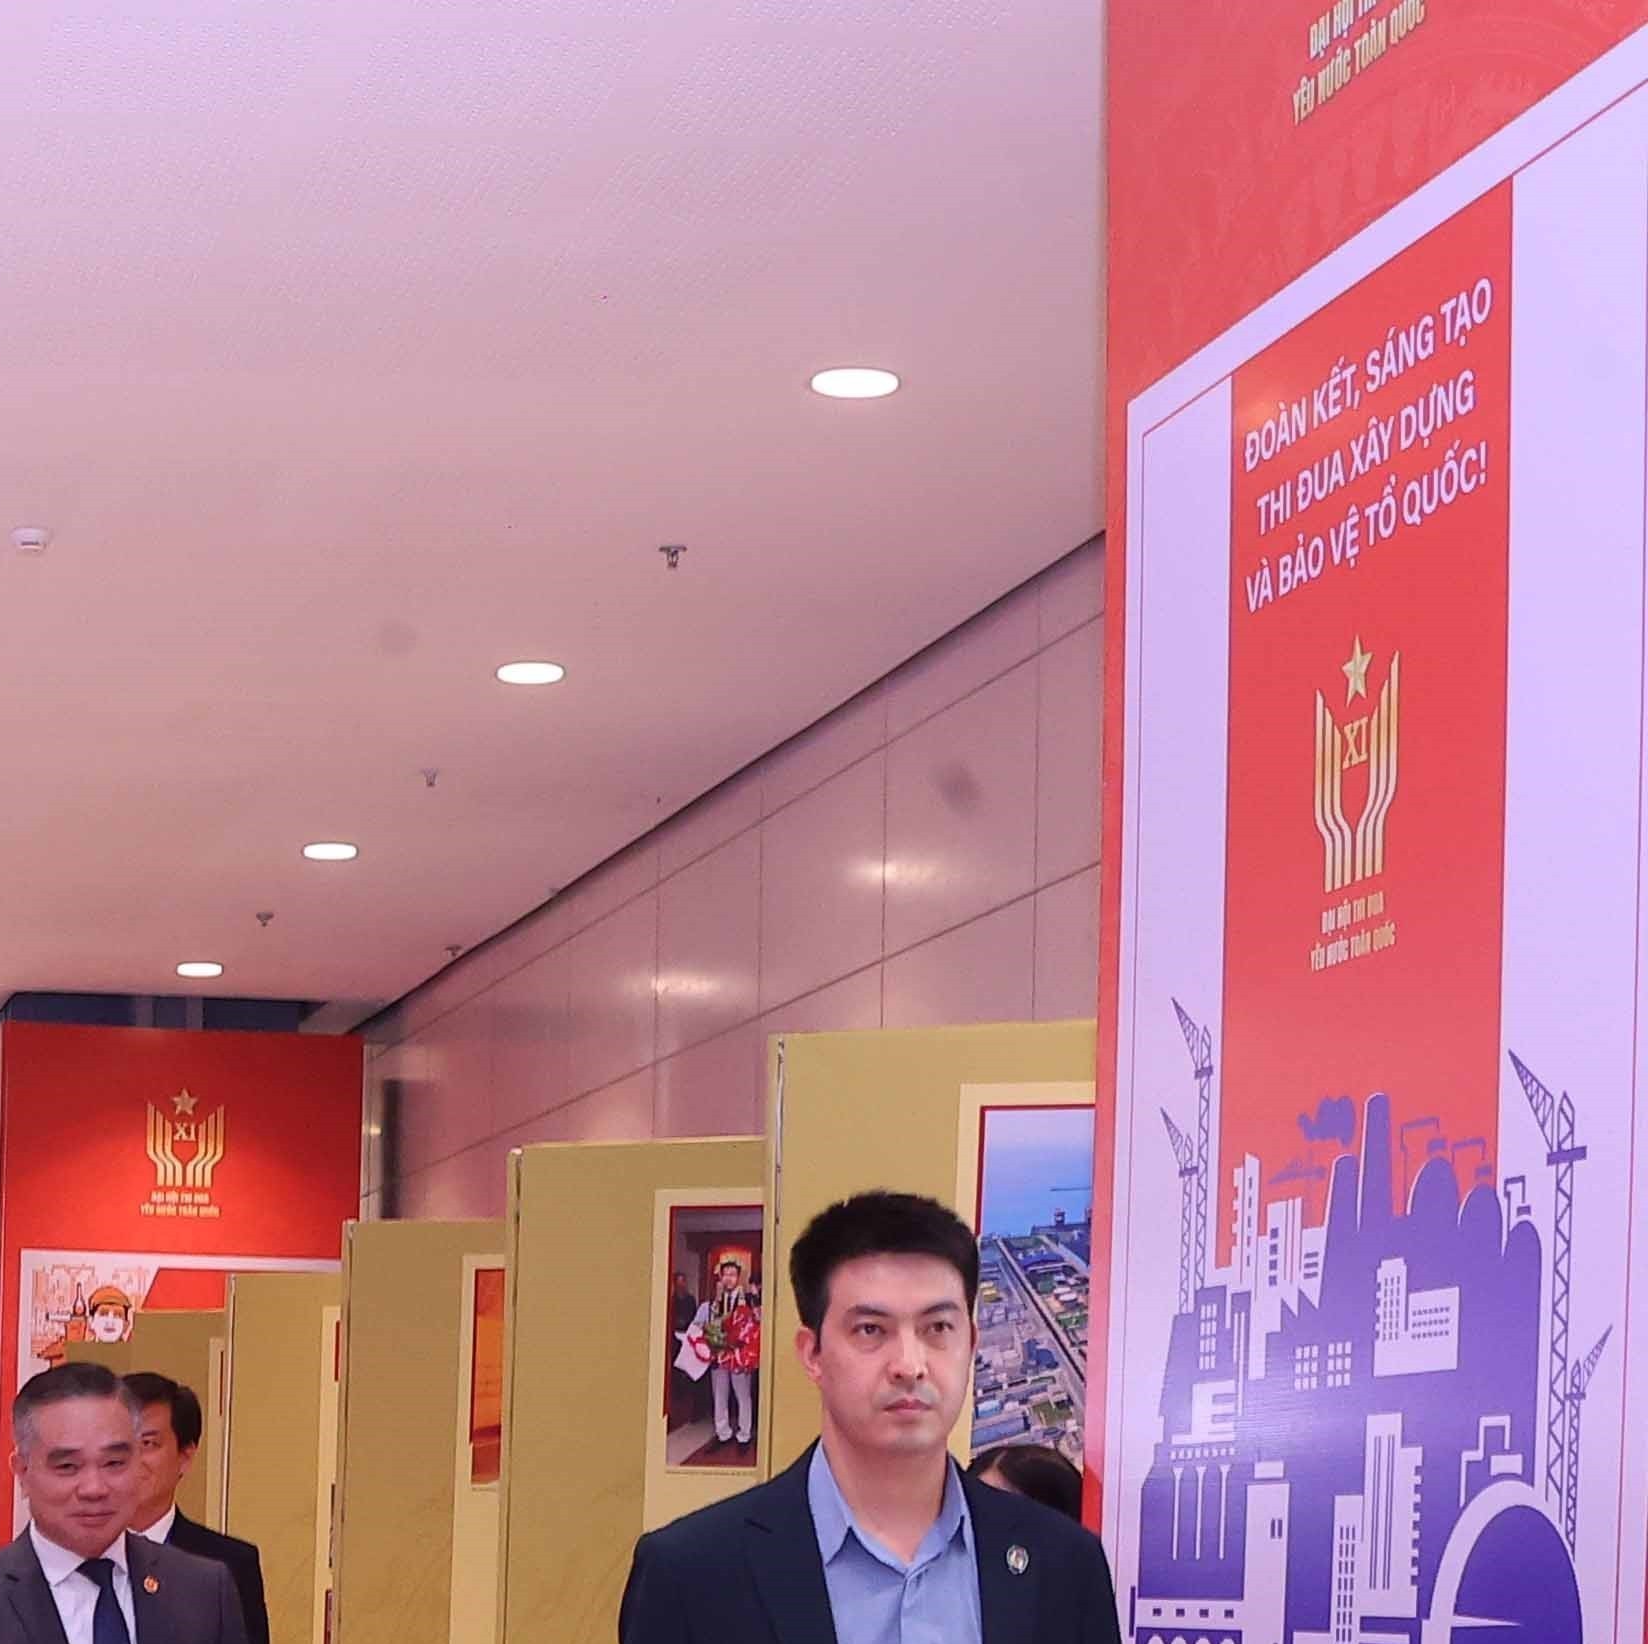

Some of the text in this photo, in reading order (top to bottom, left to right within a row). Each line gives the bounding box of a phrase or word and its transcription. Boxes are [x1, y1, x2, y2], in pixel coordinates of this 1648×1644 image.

[1244, 278, 1492, 473] ĐOÀN KẾT, SÁNG TẠO
[1256, 370, 1475, 536] THI ĐUA XÂY DỰNG
[1245, 440, 1487, 614] VÀ BẢO VỆ TỔ QUỐC!
